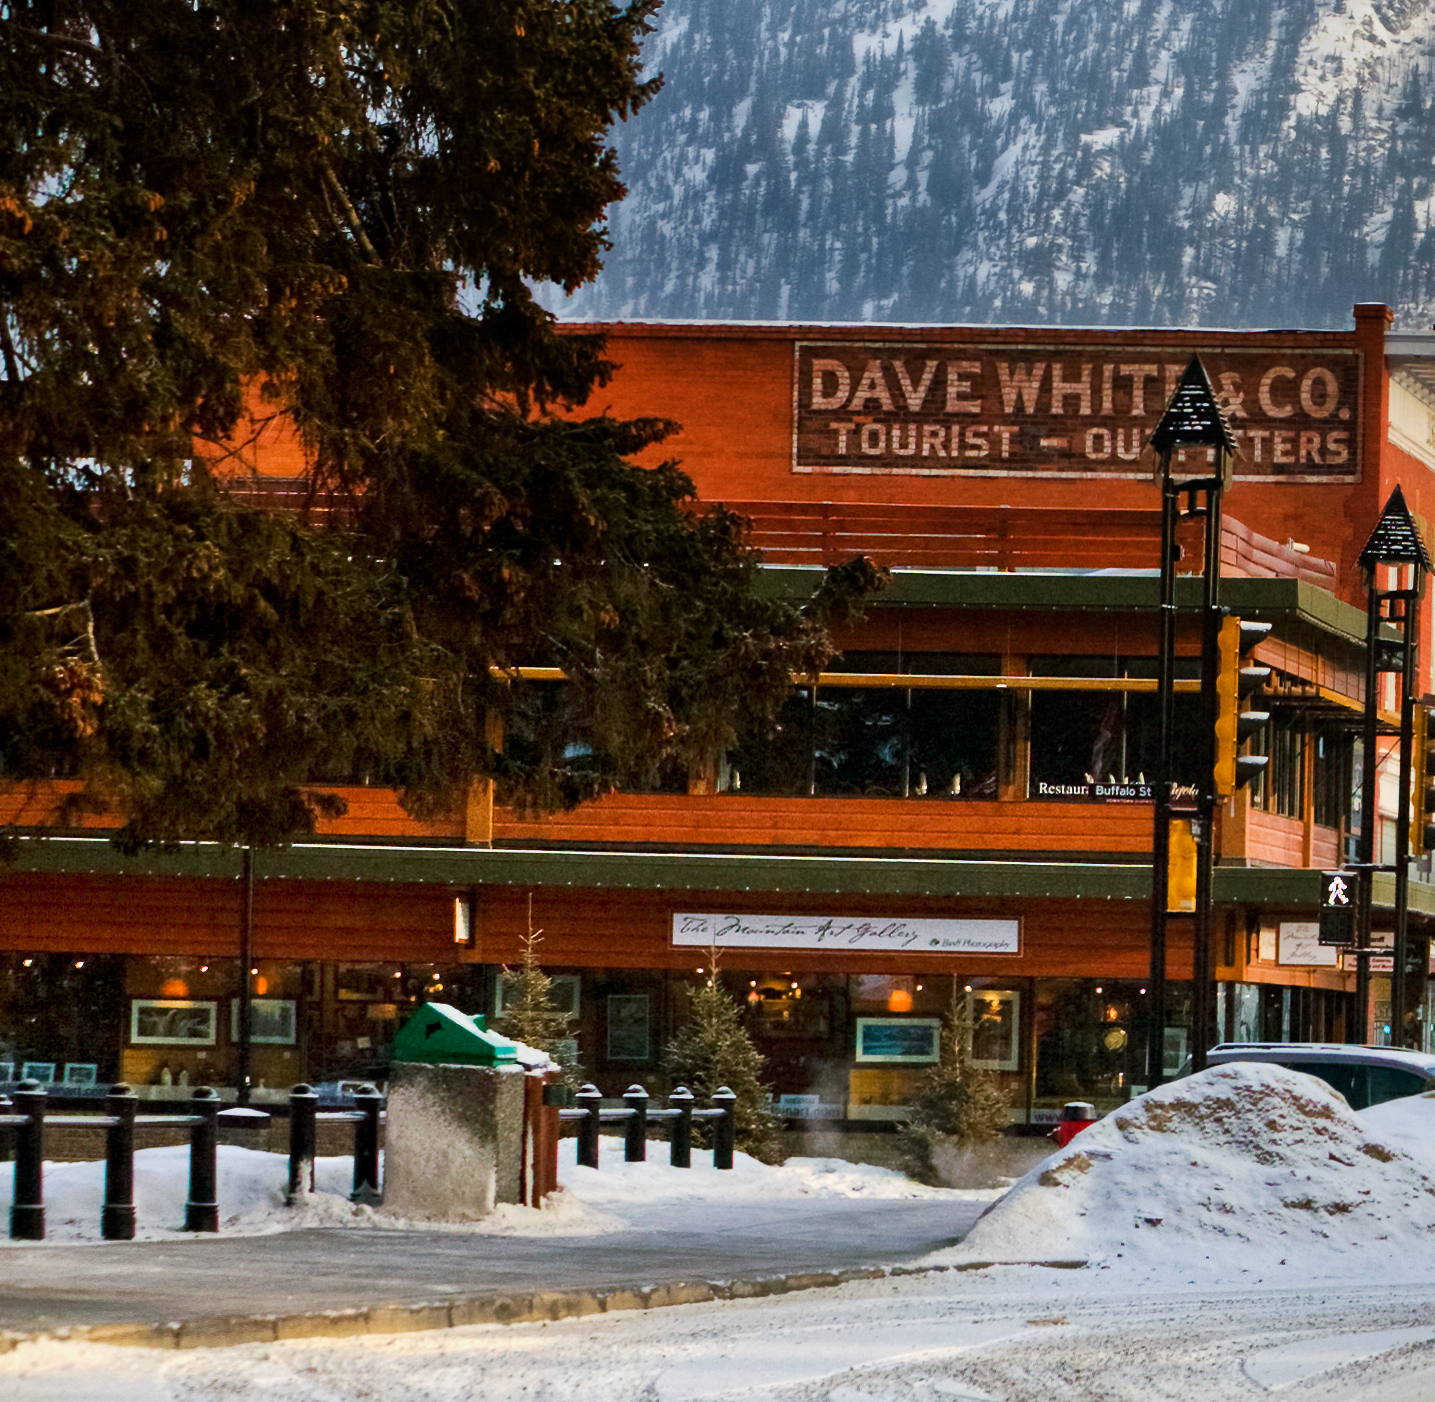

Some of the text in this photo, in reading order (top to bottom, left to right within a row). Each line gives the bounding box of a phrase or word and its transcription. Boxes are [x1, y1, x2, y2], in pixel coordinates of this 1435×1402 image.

[809, 358, 982, 413] DAVE
[1257, 365, 1351, 421] CO.
[828, 422, 1020, 458] TOURIST
[1084, 426, 1351, 465] OUTERS
[1095, 784, 1152, 798] Buffalo St
[680, 915, 921, 948] The Mountain Art Gallery
